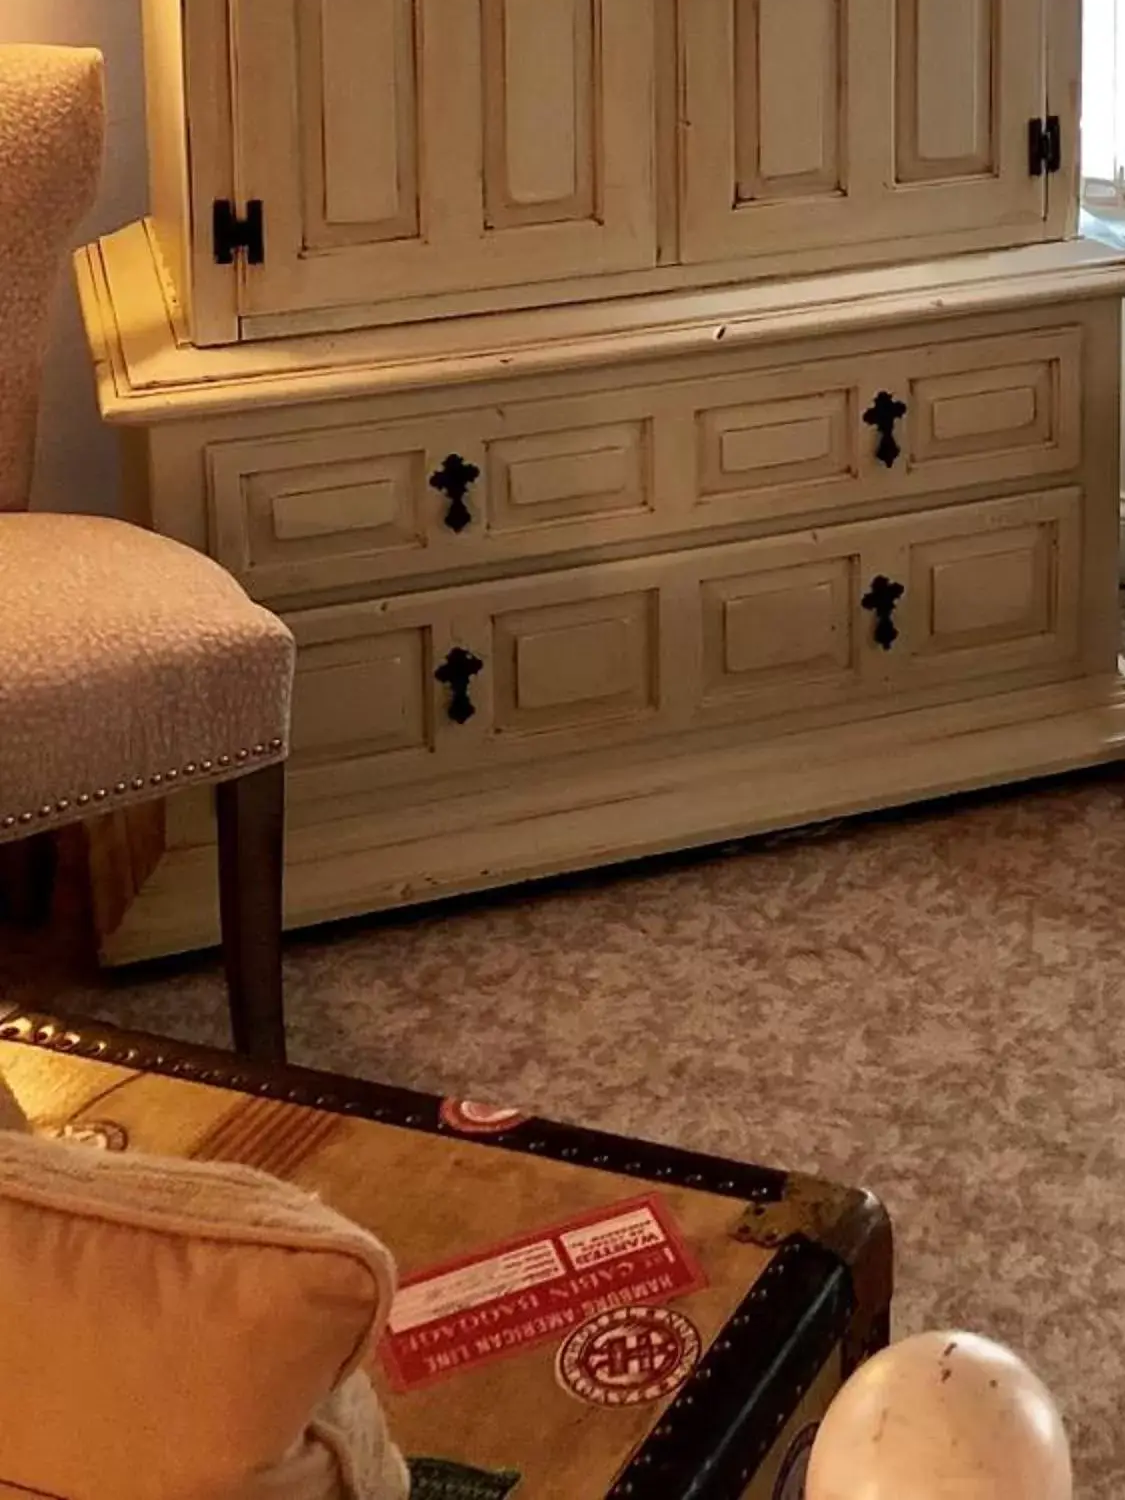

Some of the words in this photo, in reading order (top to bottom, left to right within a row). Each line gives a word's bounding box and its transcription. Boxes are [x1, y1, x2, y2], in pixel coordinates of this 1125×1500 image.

[574, 1232, 660, 1266] WANTED
[548, 1259, 636, 1302] CABIN
[398, 1293, 540, 1355] BAGGAGE
[423, 1344, 471, 1373] LINE
